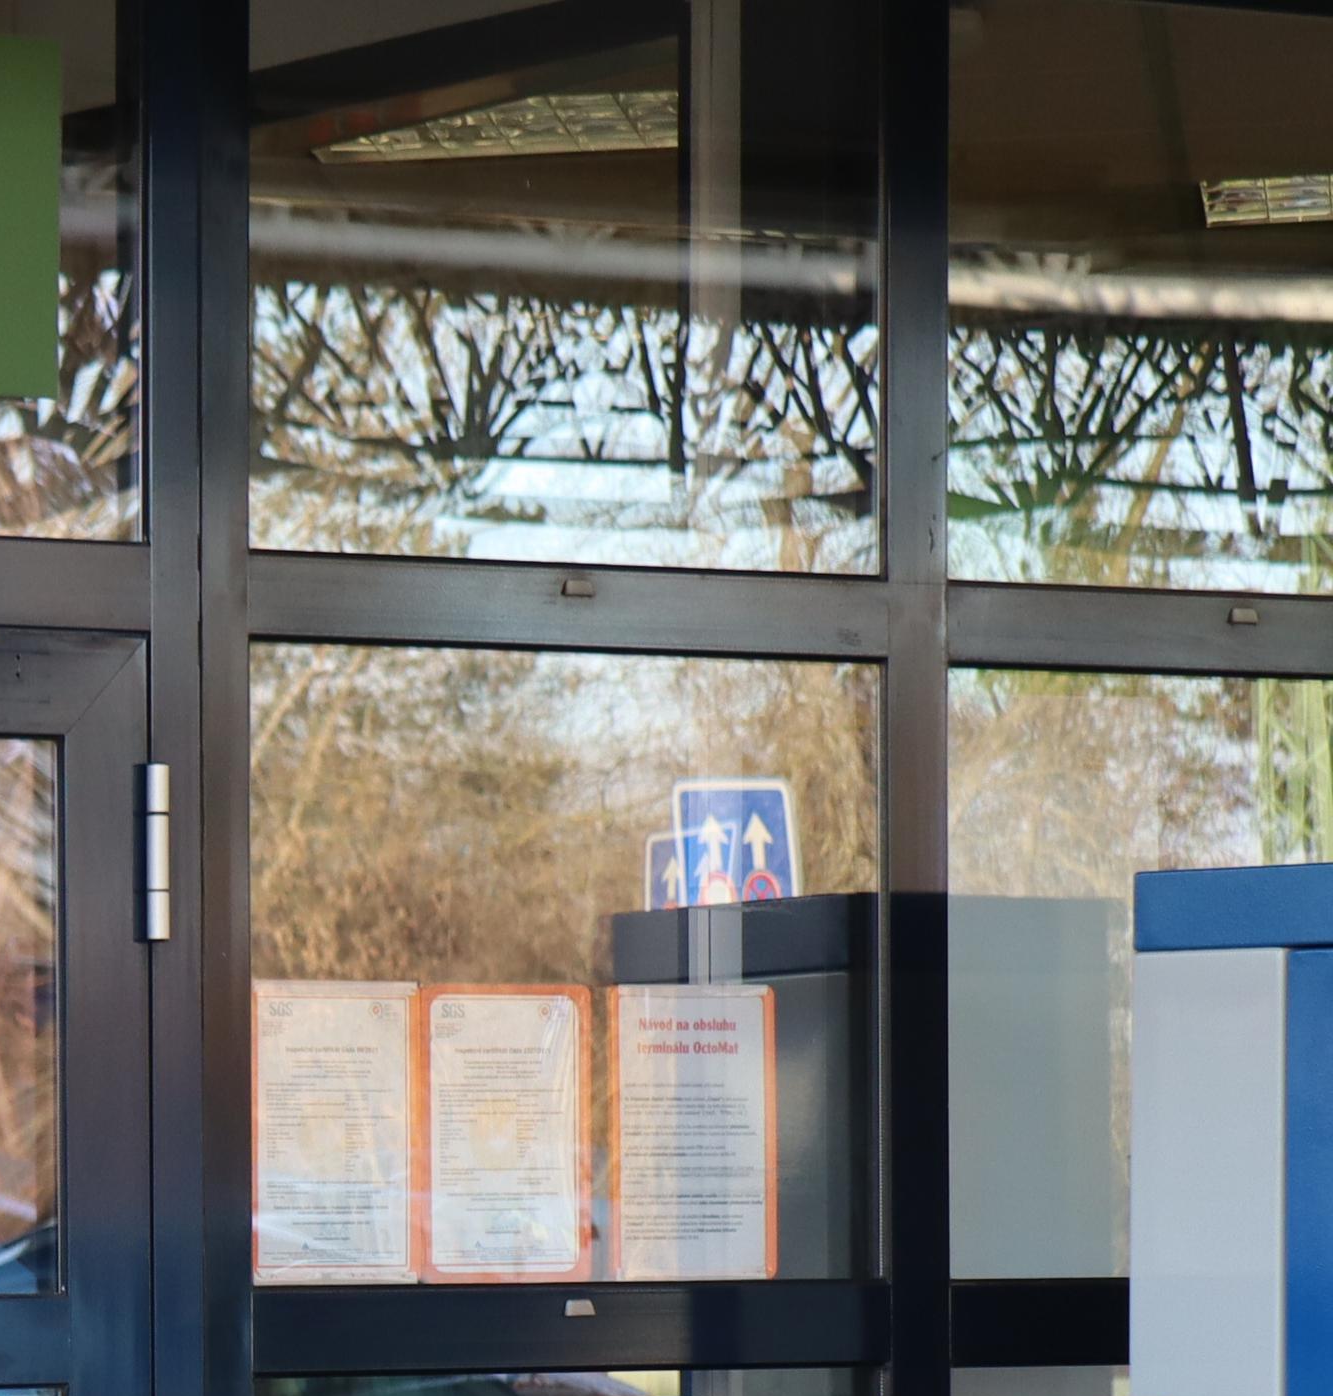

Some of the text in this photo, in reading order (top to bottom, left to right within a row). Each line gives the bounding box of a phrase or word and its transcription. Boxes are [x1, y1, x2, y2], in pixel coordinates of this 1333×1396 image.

[638, 1017, 736, 1032] Návod na obsluhu
[637, 1041, 689, 1055] terminálu
